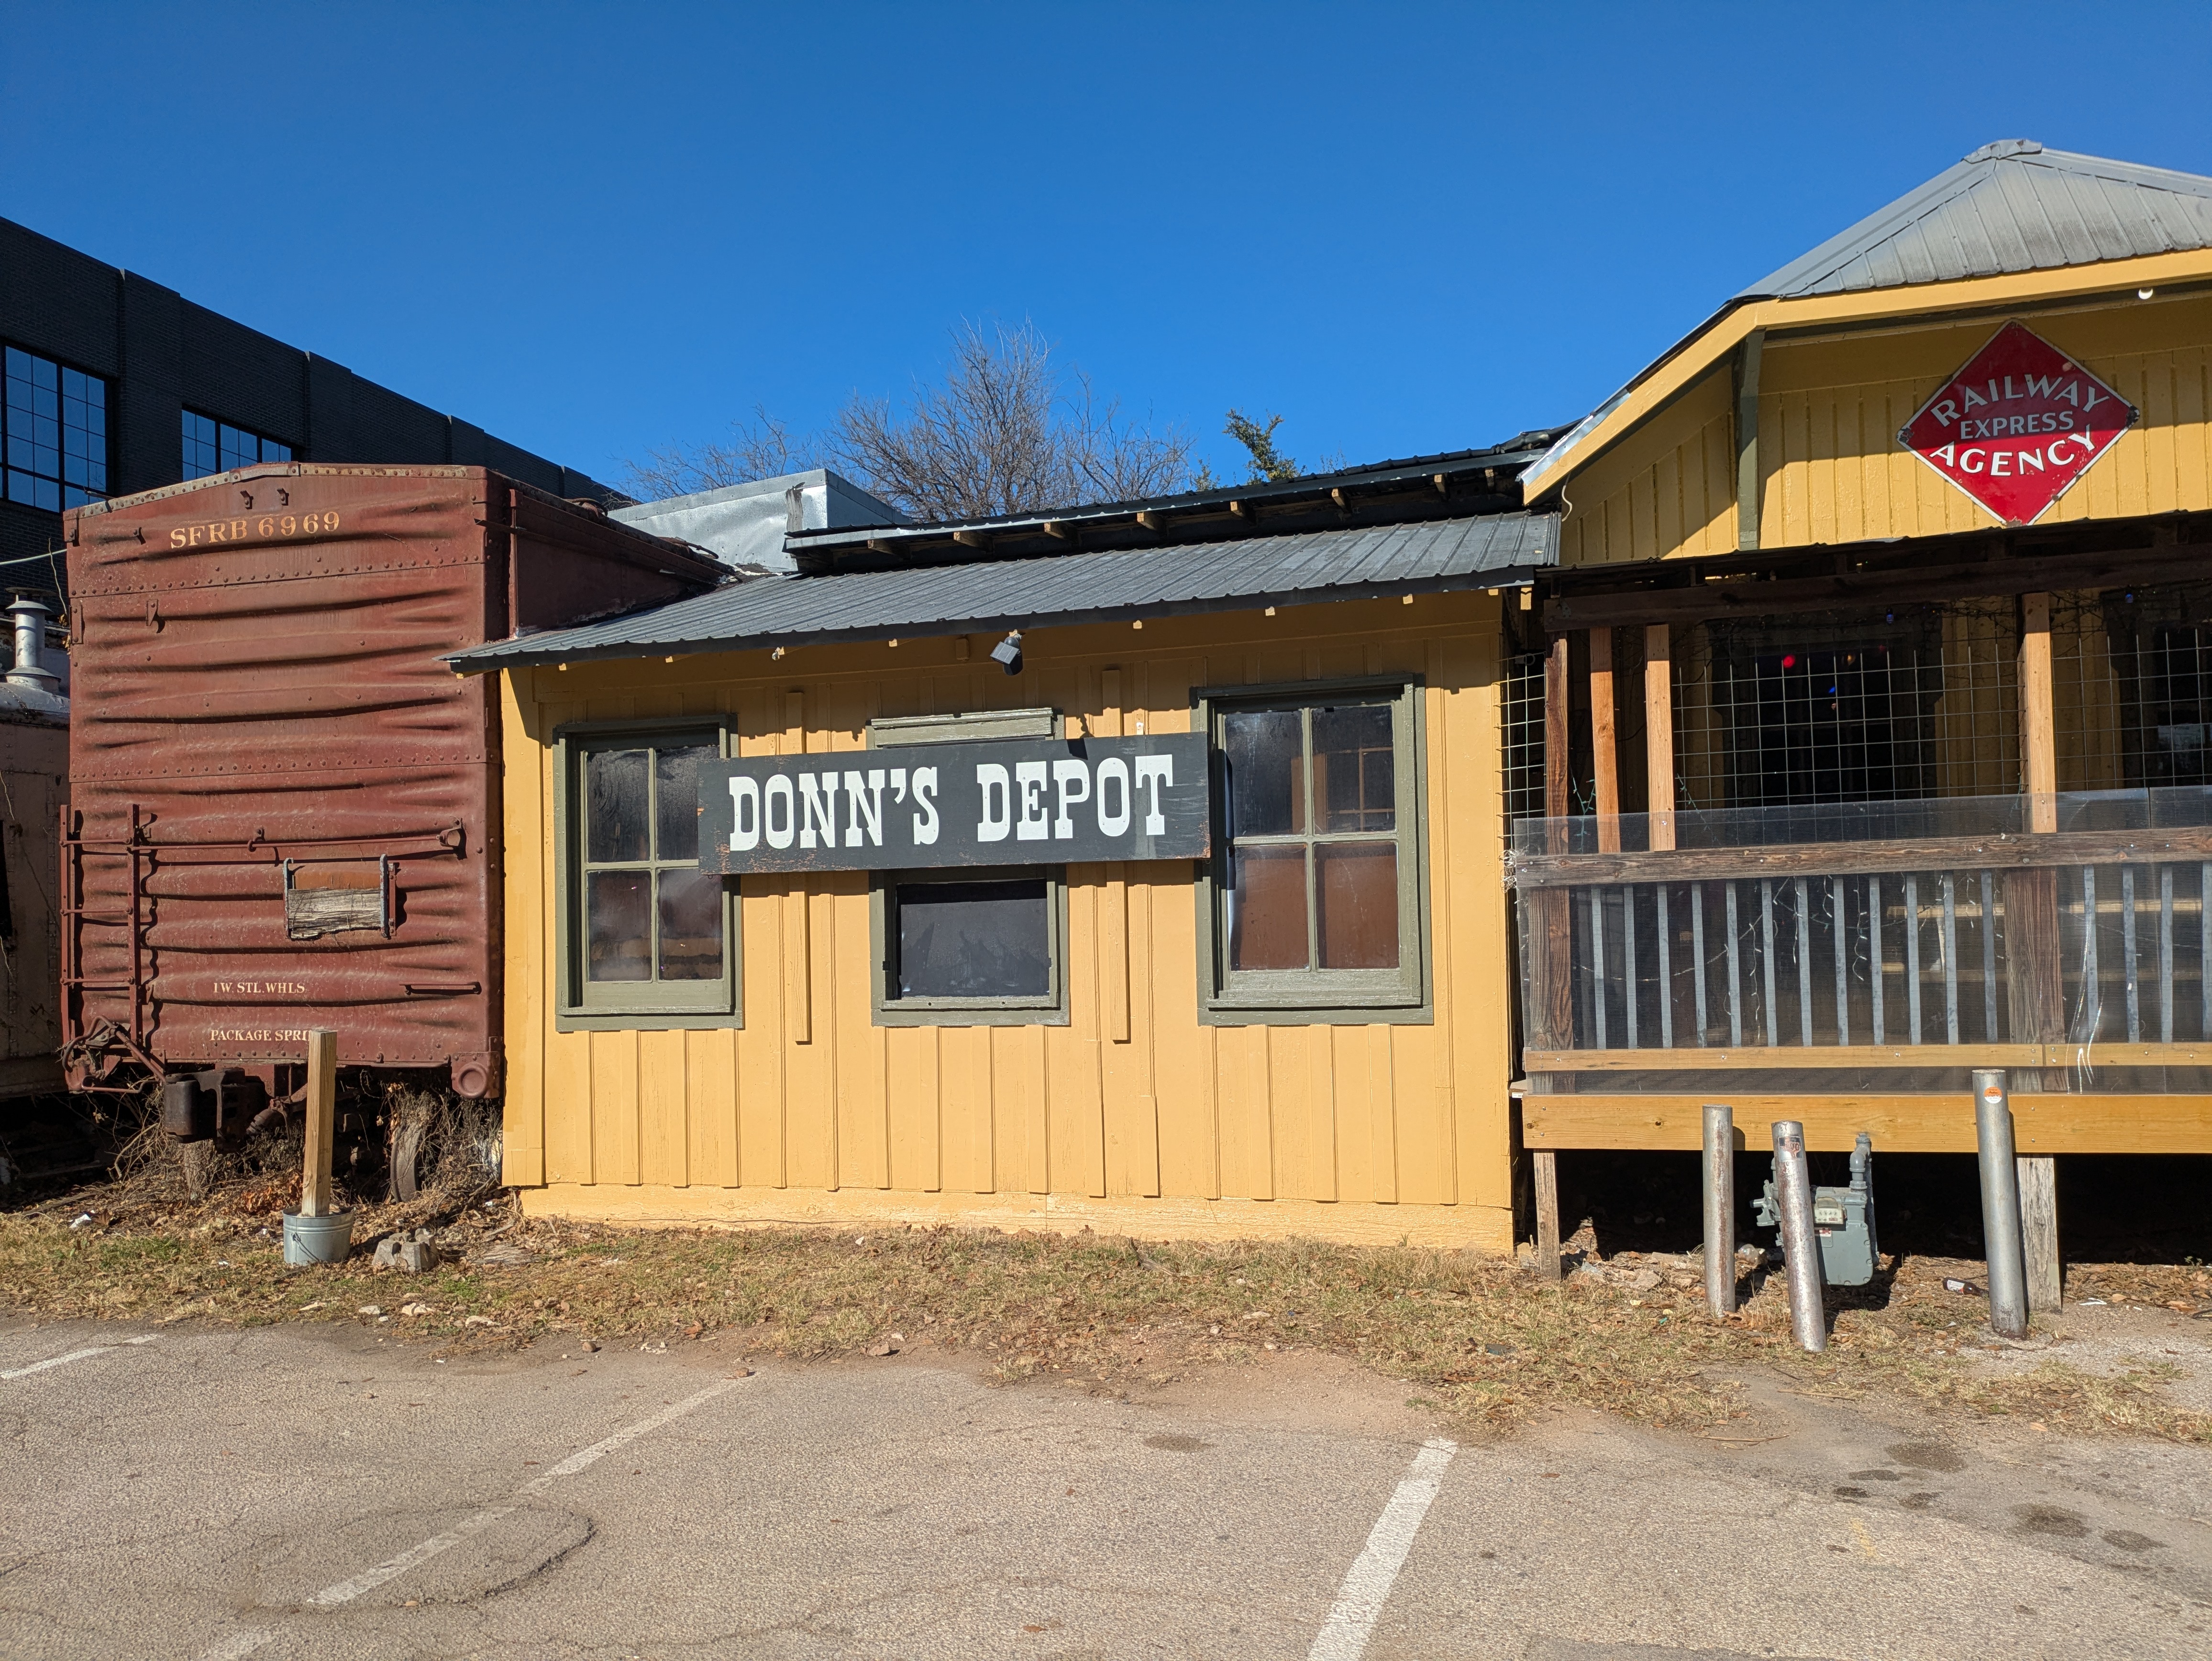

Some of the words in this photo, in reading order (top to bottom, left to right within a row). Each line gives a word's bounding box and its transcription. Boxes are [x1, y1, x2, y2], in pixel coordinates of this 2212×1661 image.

[1930, 374, 2109, 427] RAILWAY
[1961, 410, 2074, 439] EXPRESS
[1929, 424, 2095, 476] AGENCY
[170, 520, 247, 549] SFRB
[258, 511, 339, 537] 6969
[729, 766, 939, 851] DONN'S
[976, 754, 1173, 842] DEPOT
[210, 1030, 271, 1041] PACKAGE
[275, 1030, 310, 1041] SPRI
